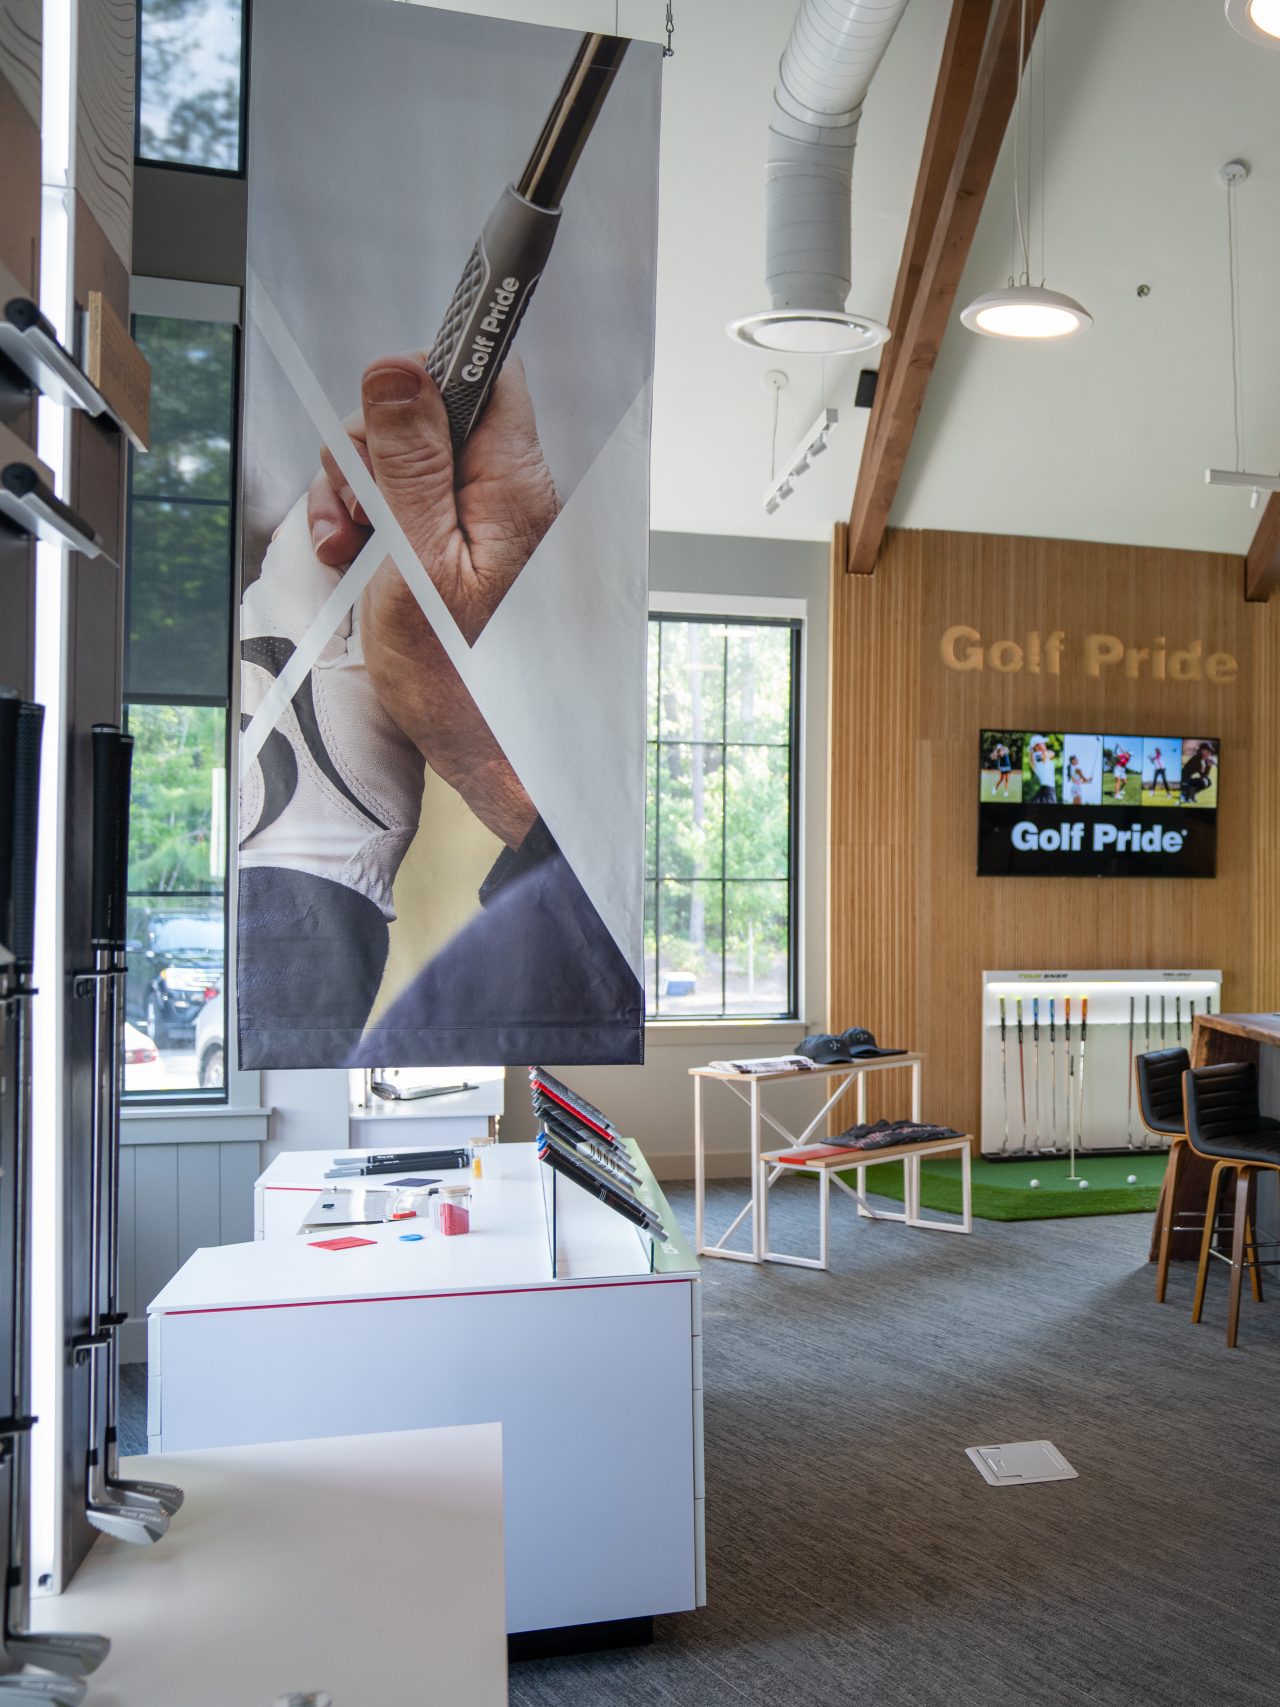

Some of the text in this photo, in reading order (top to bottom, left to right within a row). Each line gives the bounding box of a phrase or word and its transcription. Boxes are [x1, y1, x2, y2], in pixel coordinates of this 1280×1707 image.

[462, 276, 519, 382] Golf Pride
[940, 624, 1239, 684] Golf Pride
[1011, 821, 1183, 852] Golf Pride
